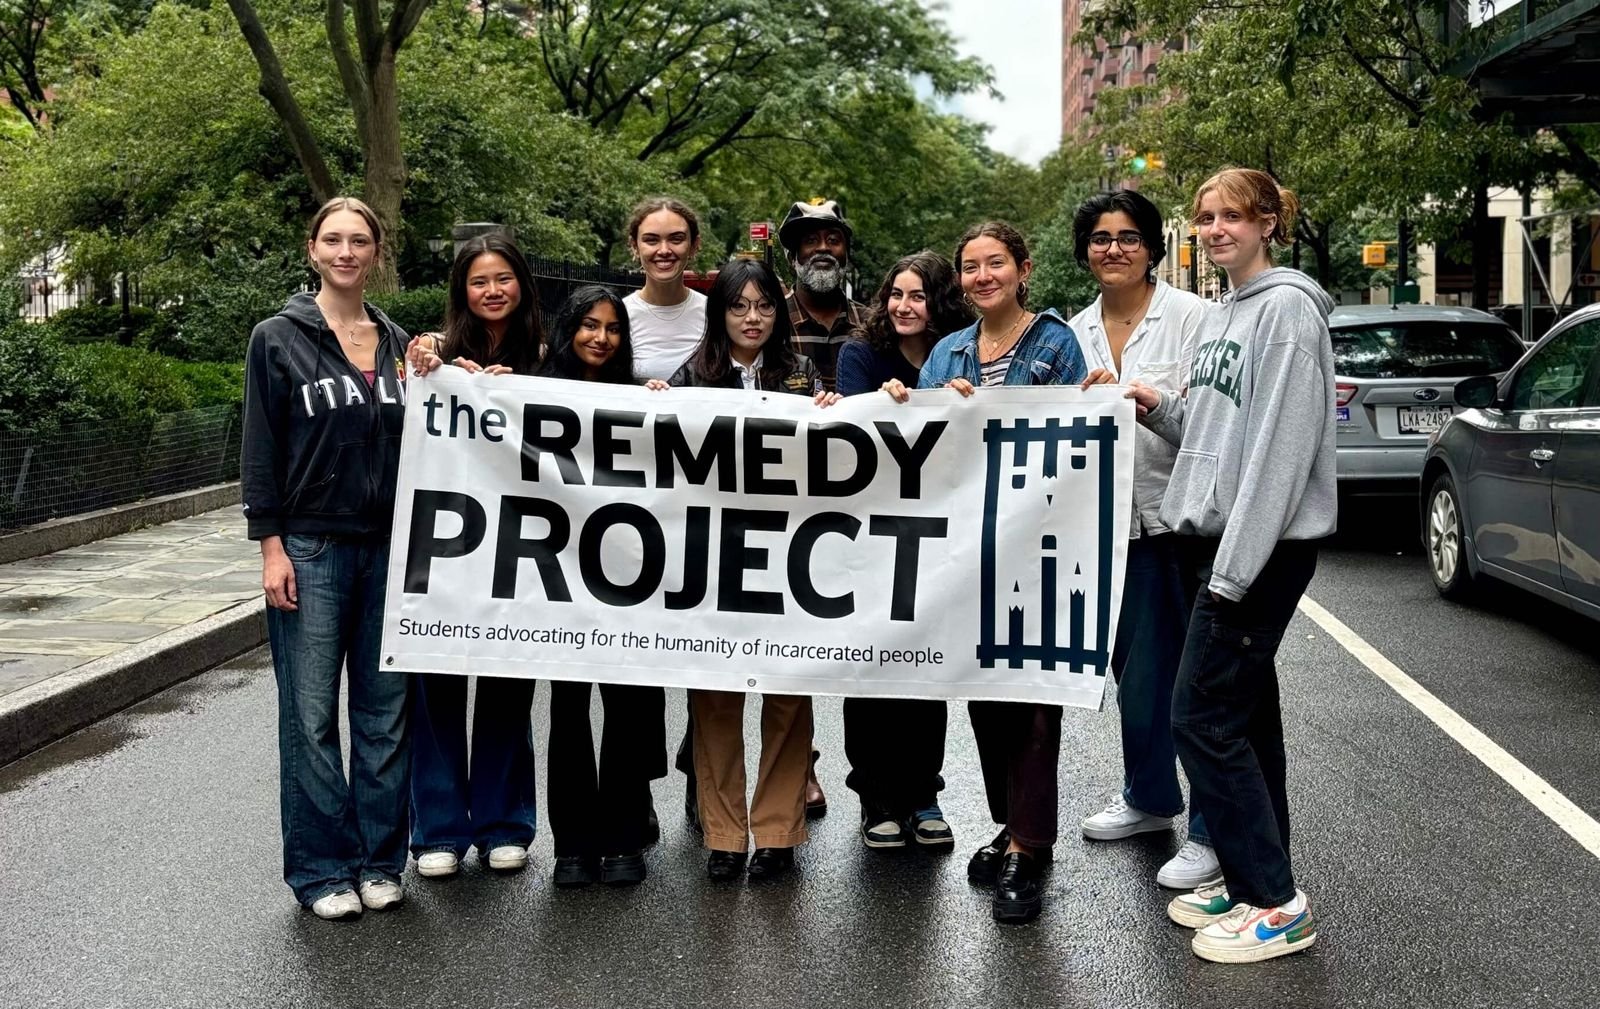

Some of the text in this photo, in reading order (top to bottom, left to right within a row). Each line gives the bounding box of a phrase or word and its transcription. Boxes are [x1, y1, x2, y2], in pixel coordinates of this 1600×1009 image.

[423, 393, 950, 500] the REMEDY
[403, 488, 949, 622] PROJECT
[398, 618, 944, 668] Students advocating for the humanity of incarcerated people
